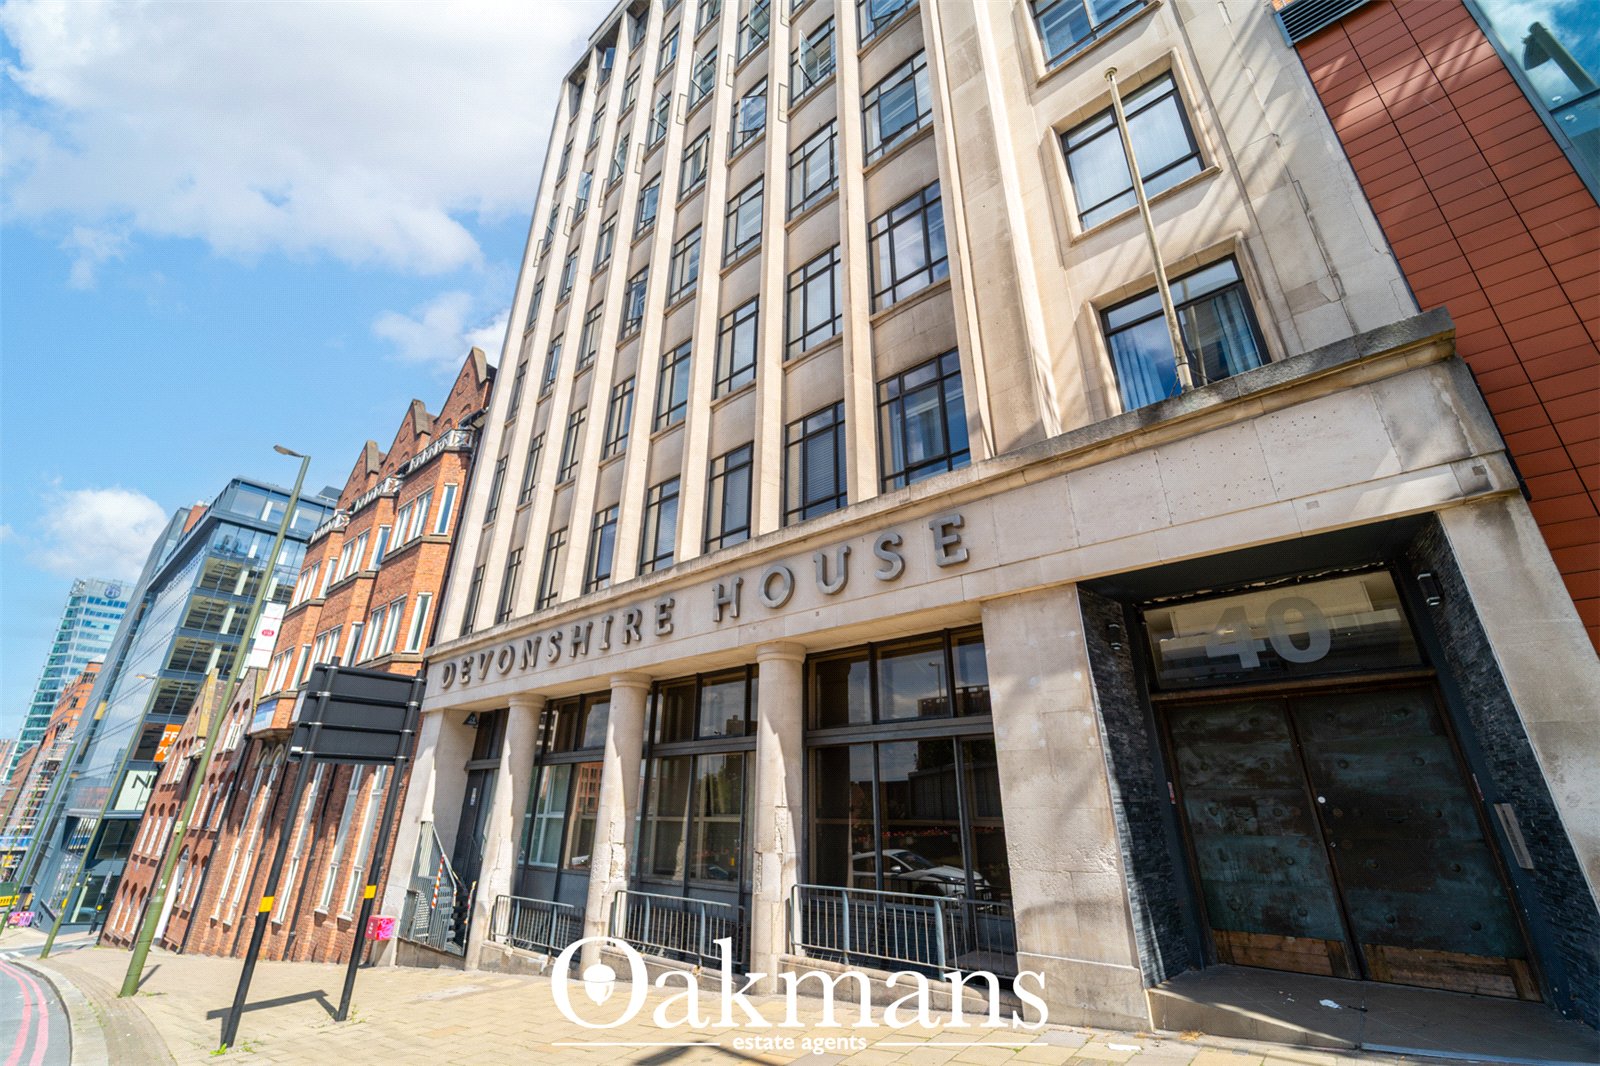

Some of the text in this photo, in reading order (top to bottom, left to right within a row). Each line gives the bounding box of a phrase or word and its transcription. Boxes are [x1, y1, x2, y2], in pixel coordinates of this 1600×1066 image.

[442, 514, 969, 689] DEVONSHIRE HOUSE
[1206, 597, 1331, 668] 40
